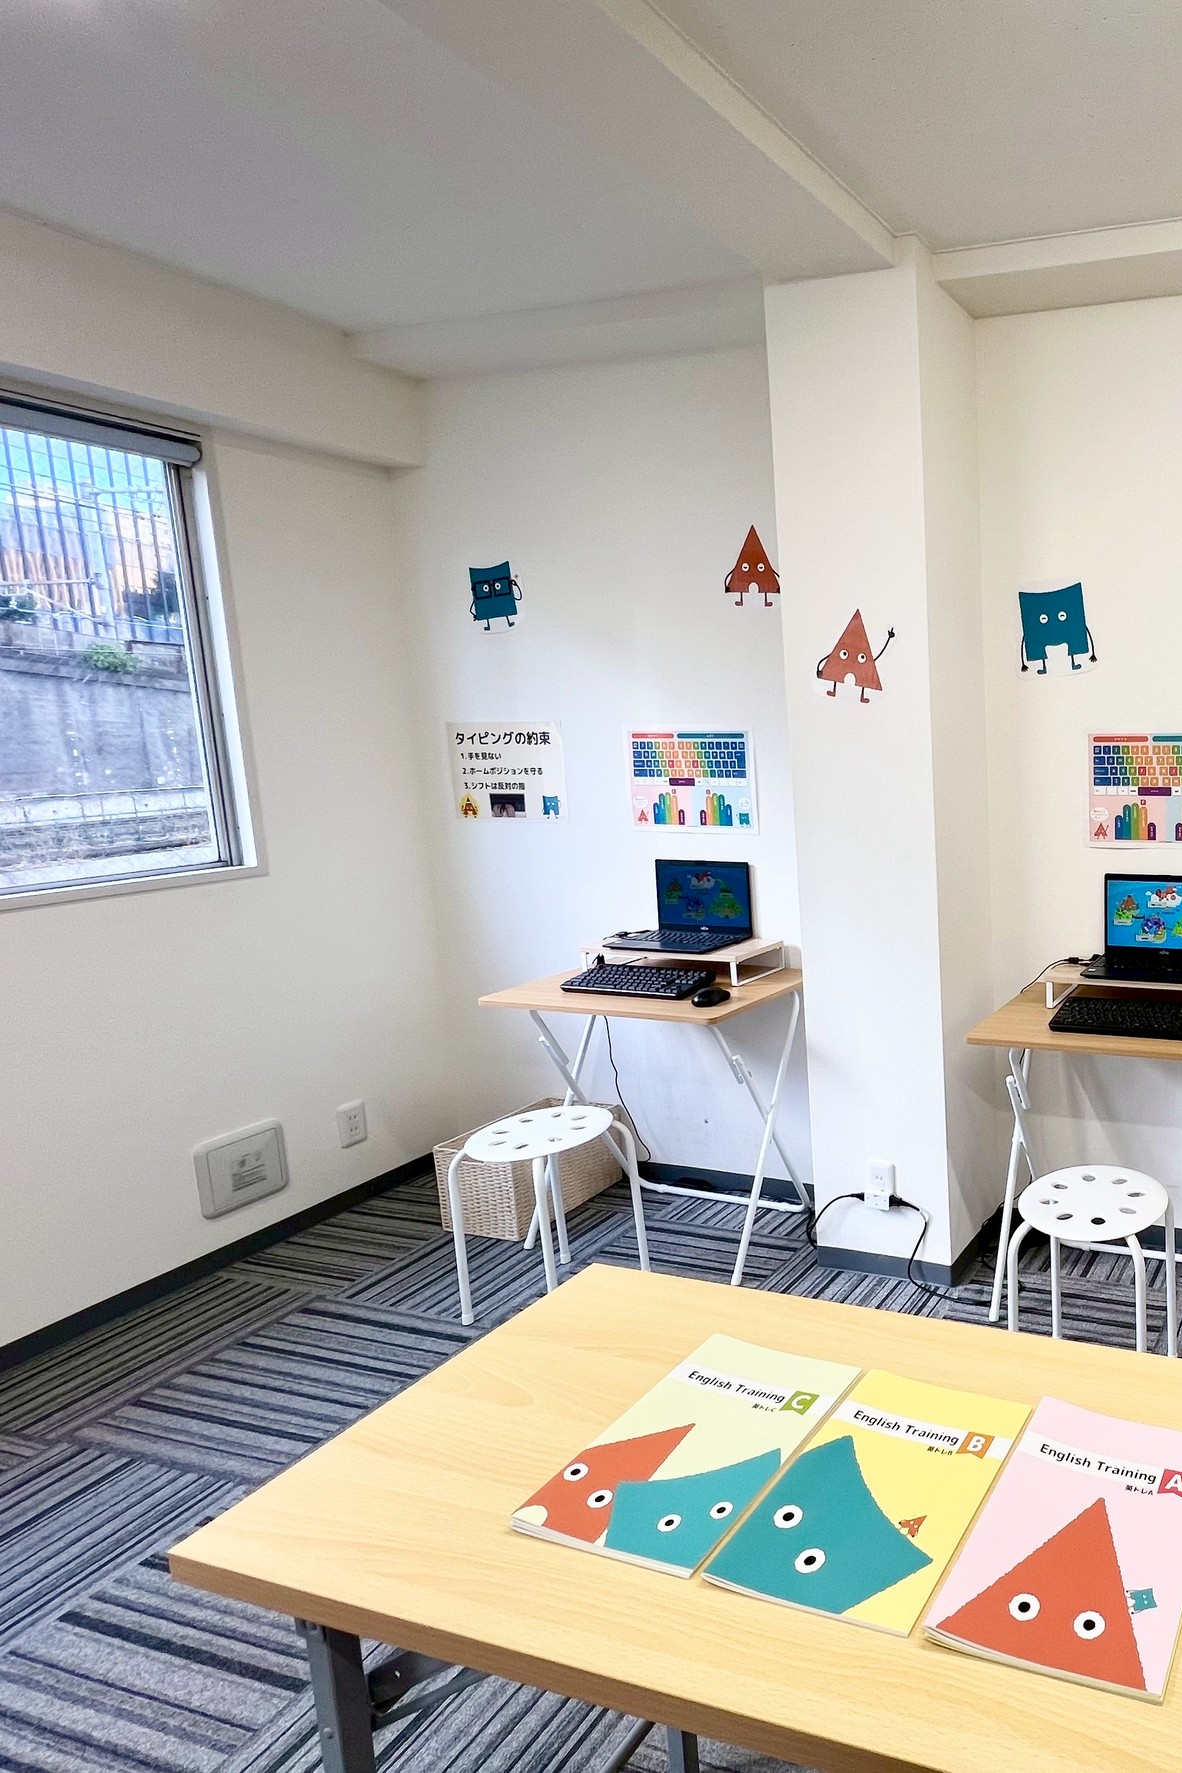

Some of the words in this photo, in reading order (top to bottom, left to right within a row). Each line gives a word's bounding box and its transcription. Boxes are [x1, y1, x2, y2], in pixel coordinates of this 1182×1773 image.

[455, 731, 551, 745] タイピングの約束
[688, 1370, 732, 1391] English
[736, 1383, 786, 1404] Training
[791, 1394, 812, 1410] C
[853, 1409, 900, 1432] English
[905, 1424, 959, 1446] Training
[966, 1435, 986, 1452] B
[1039, 1443, 1091, 1469] English
[1097, 1461, 1157, 1485] Training
